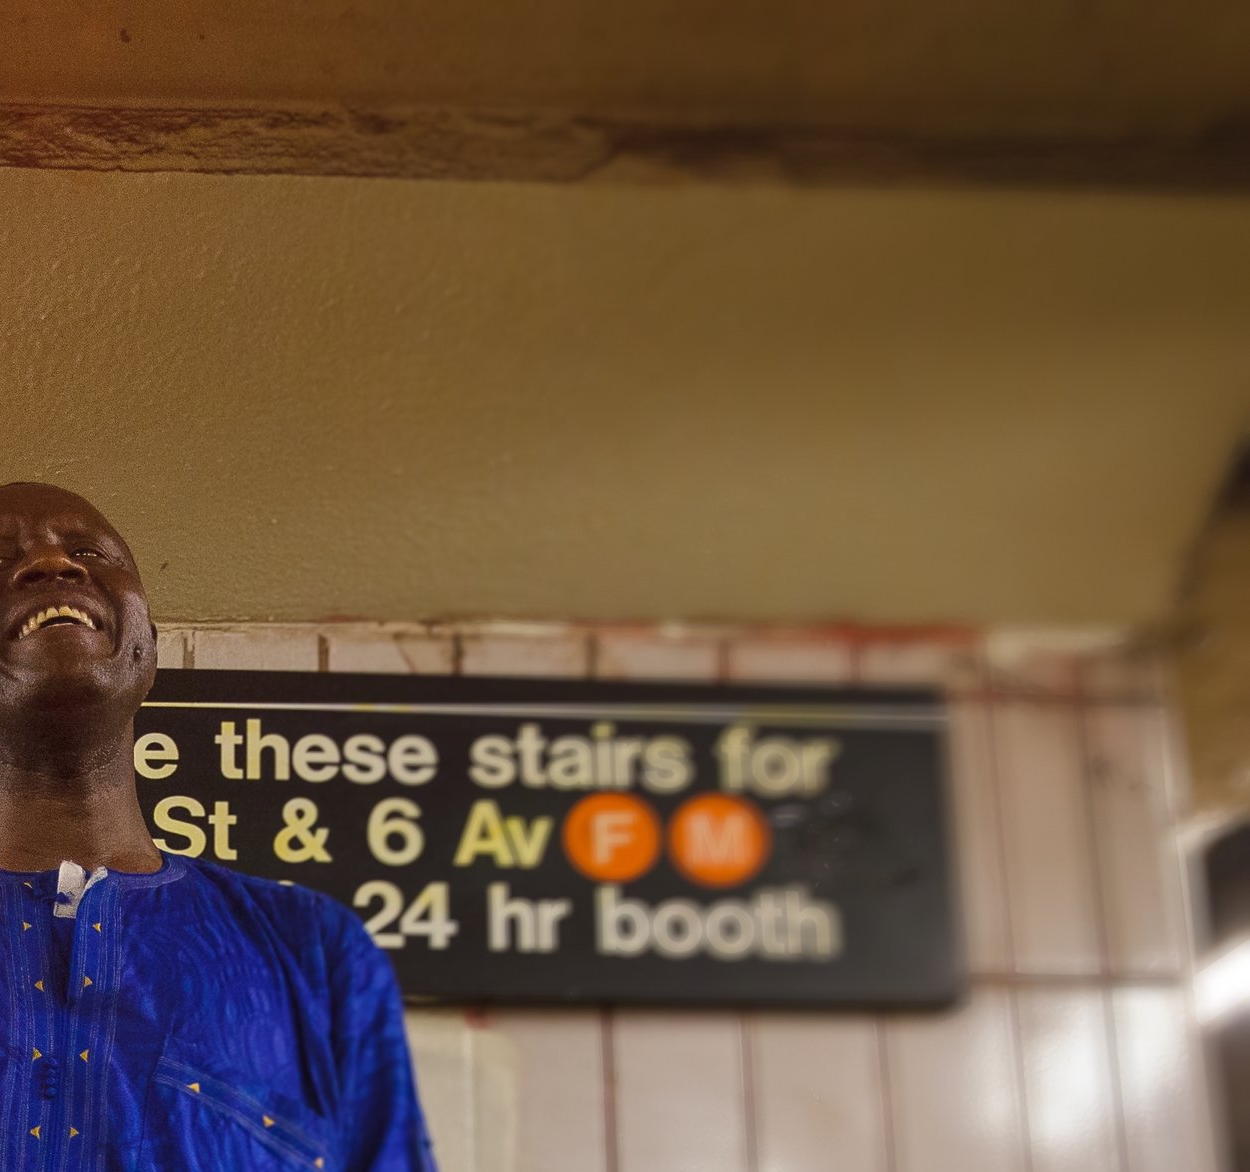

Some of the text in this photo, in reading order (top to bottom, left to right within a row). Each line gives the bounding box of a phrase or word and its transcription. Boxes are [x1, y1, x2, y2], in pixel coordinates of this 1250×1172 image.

[215, 719, 439, 785] these
[468, 722, 693, 793] stairs
[715, 719, 841, 796] for
[153, 796, 748, 868] St & 6 Av F M
[354, 880, 842, 959] 24 hr booth
